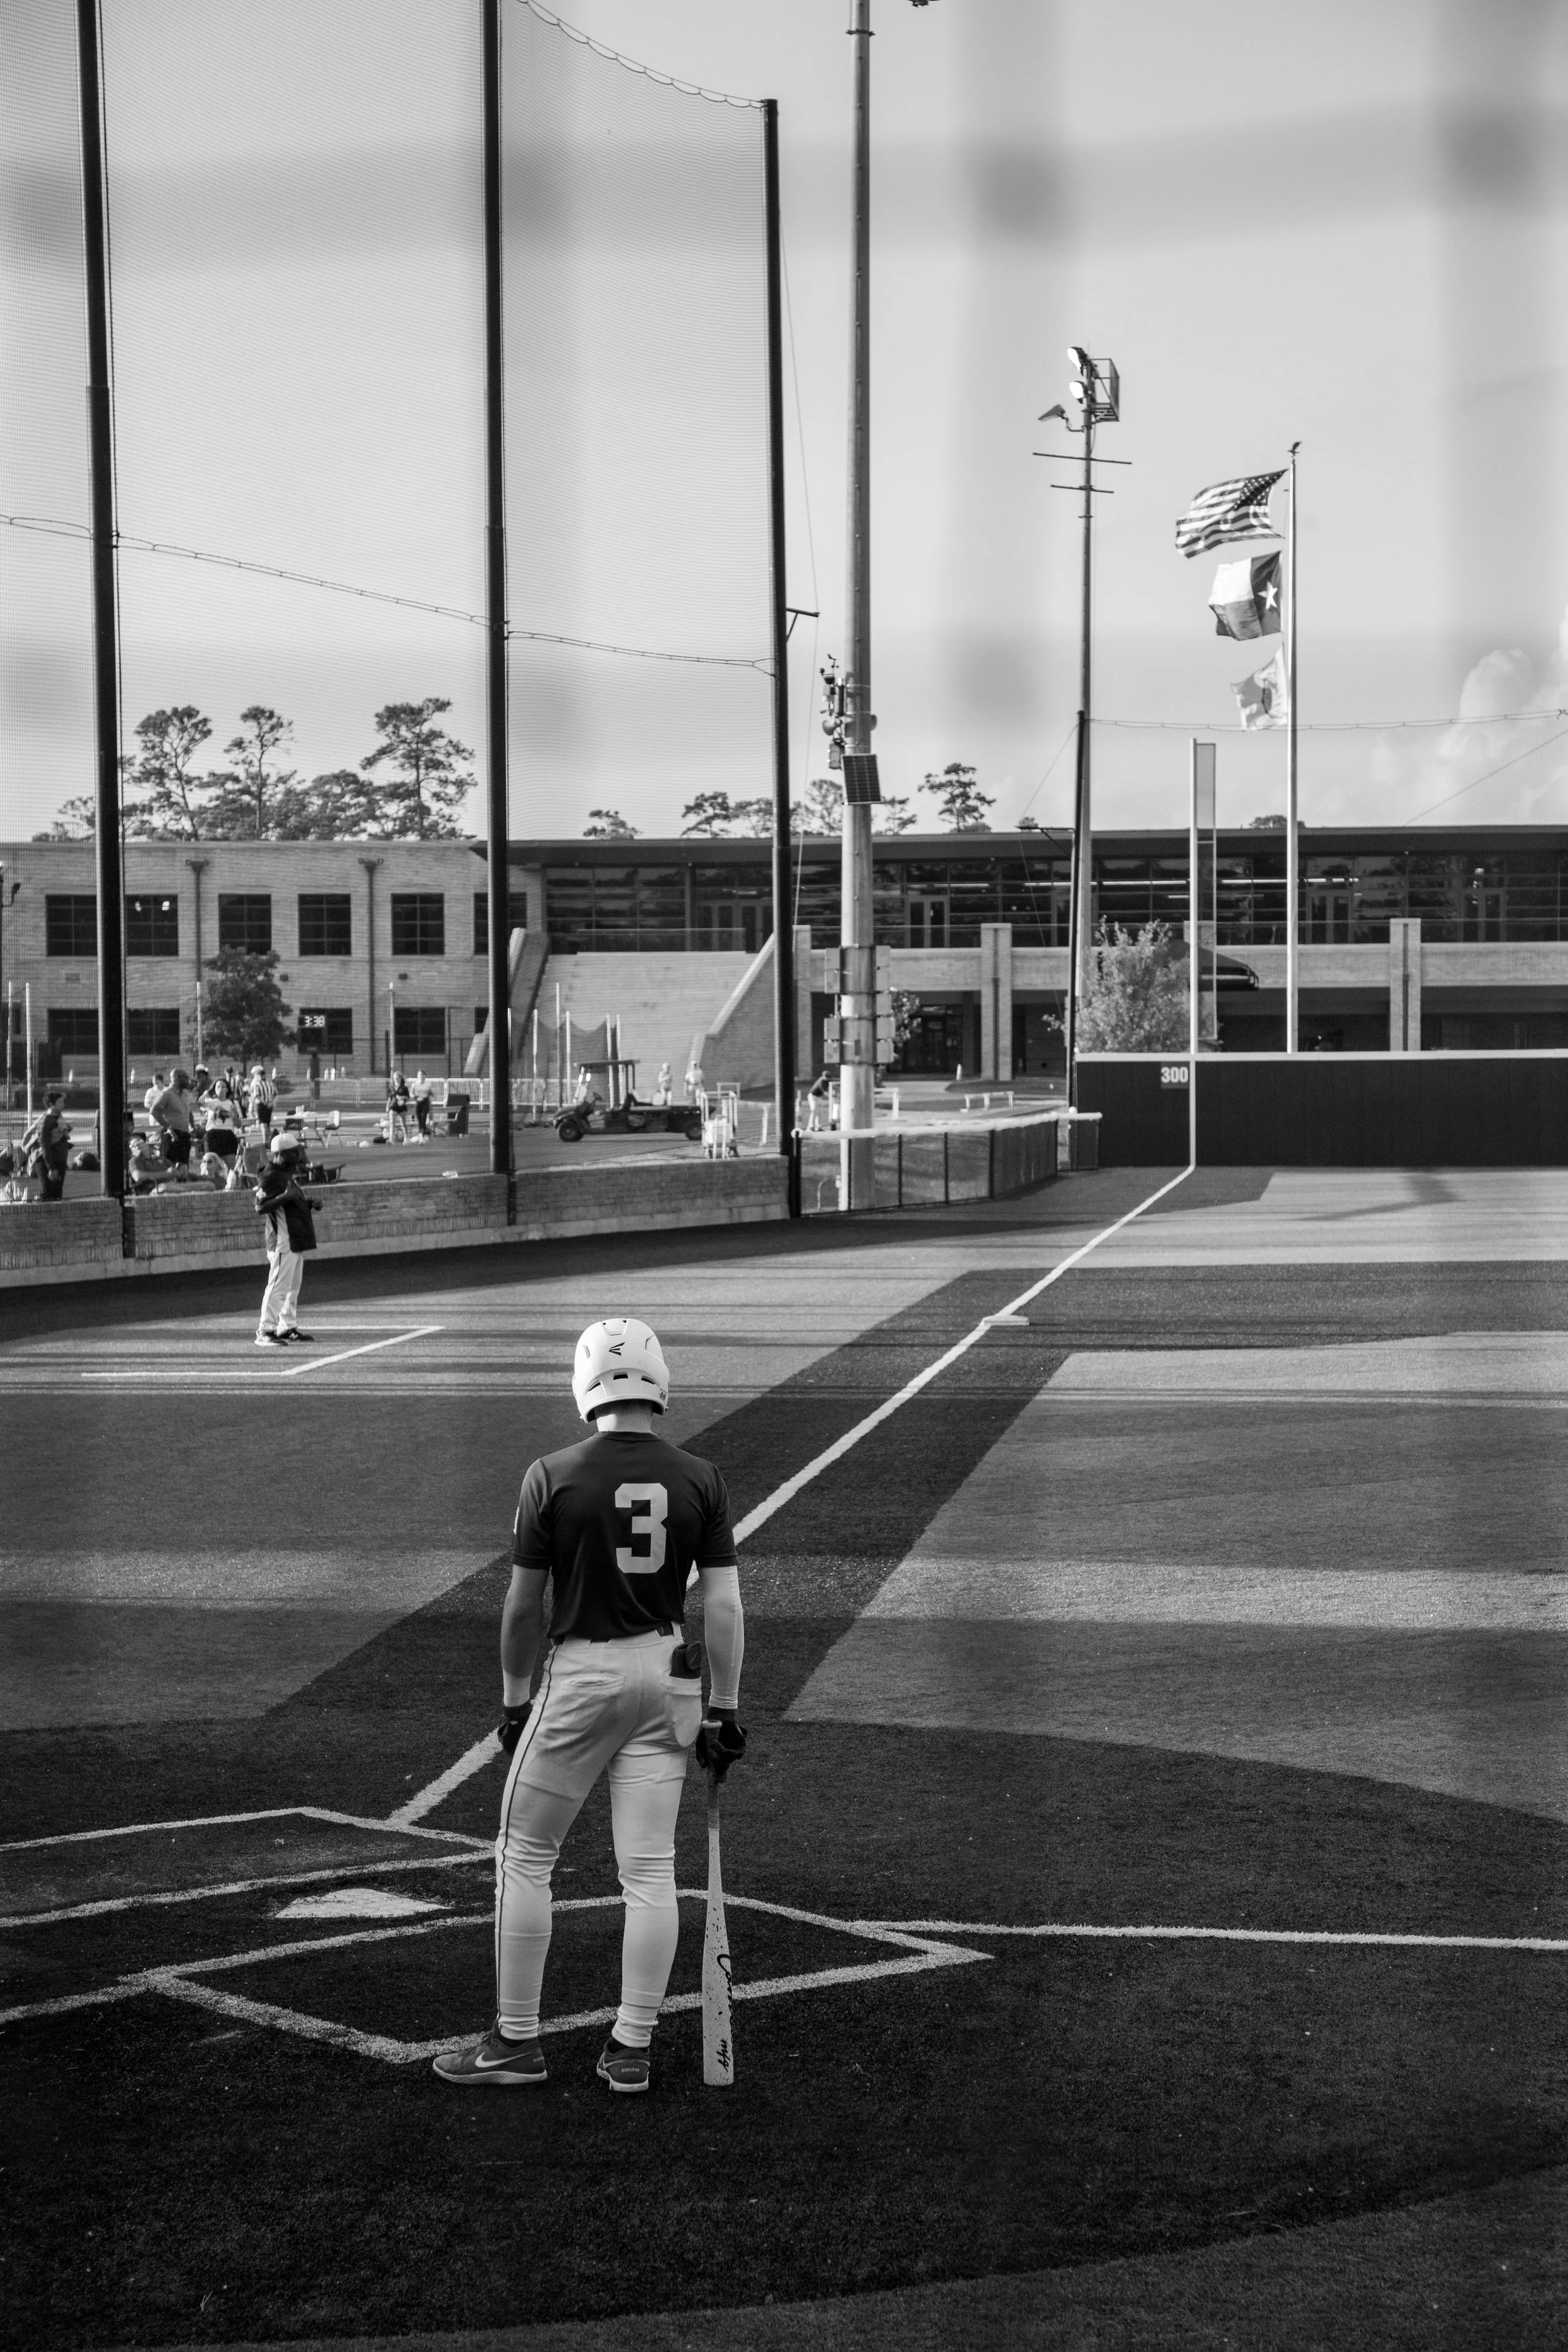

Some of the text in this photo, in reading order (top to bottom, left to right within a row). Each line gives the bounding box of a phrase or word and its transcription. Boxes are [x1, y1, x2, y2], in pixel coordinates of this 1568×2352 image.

[304, 1015, 326, 1027] 3:38
[1161, 1066, 1189, 1083] 300
[615, 1483, 668, 1574] 3
